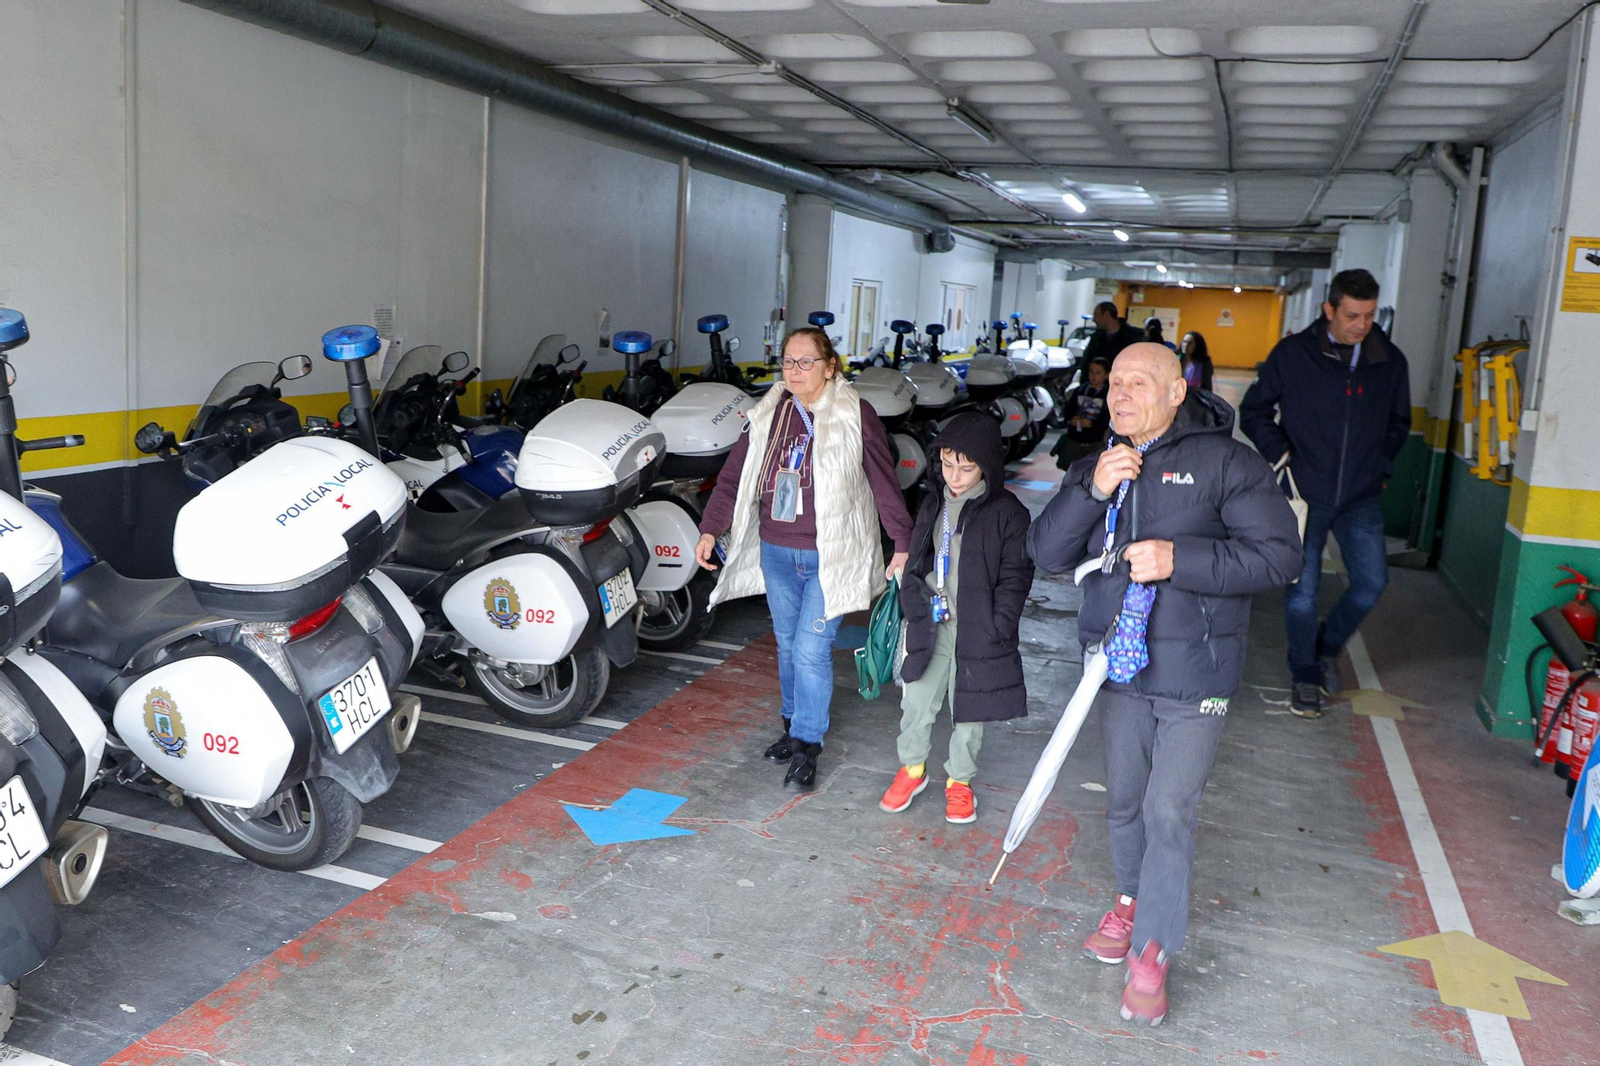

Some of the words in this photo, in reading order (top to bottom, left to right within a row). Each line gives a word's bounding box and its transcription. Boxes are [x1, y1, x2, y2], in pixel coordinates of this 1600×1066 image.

[602, 433, 633, 461] POLICÍA
[275, 485, 332, 527] POLICÍA
[333, 458, 374, 484] LOCAL
[1162, 472, 1195, 485] FILA
[654, 544, 680, 558] 092
[525, 608, 555, 624] 092
[612, 590, 632, 618] HCL
[333, 665, 376, 713] 3701
[346, 696, 381, 735] HCL
[203, 732, 240, 755] 092
